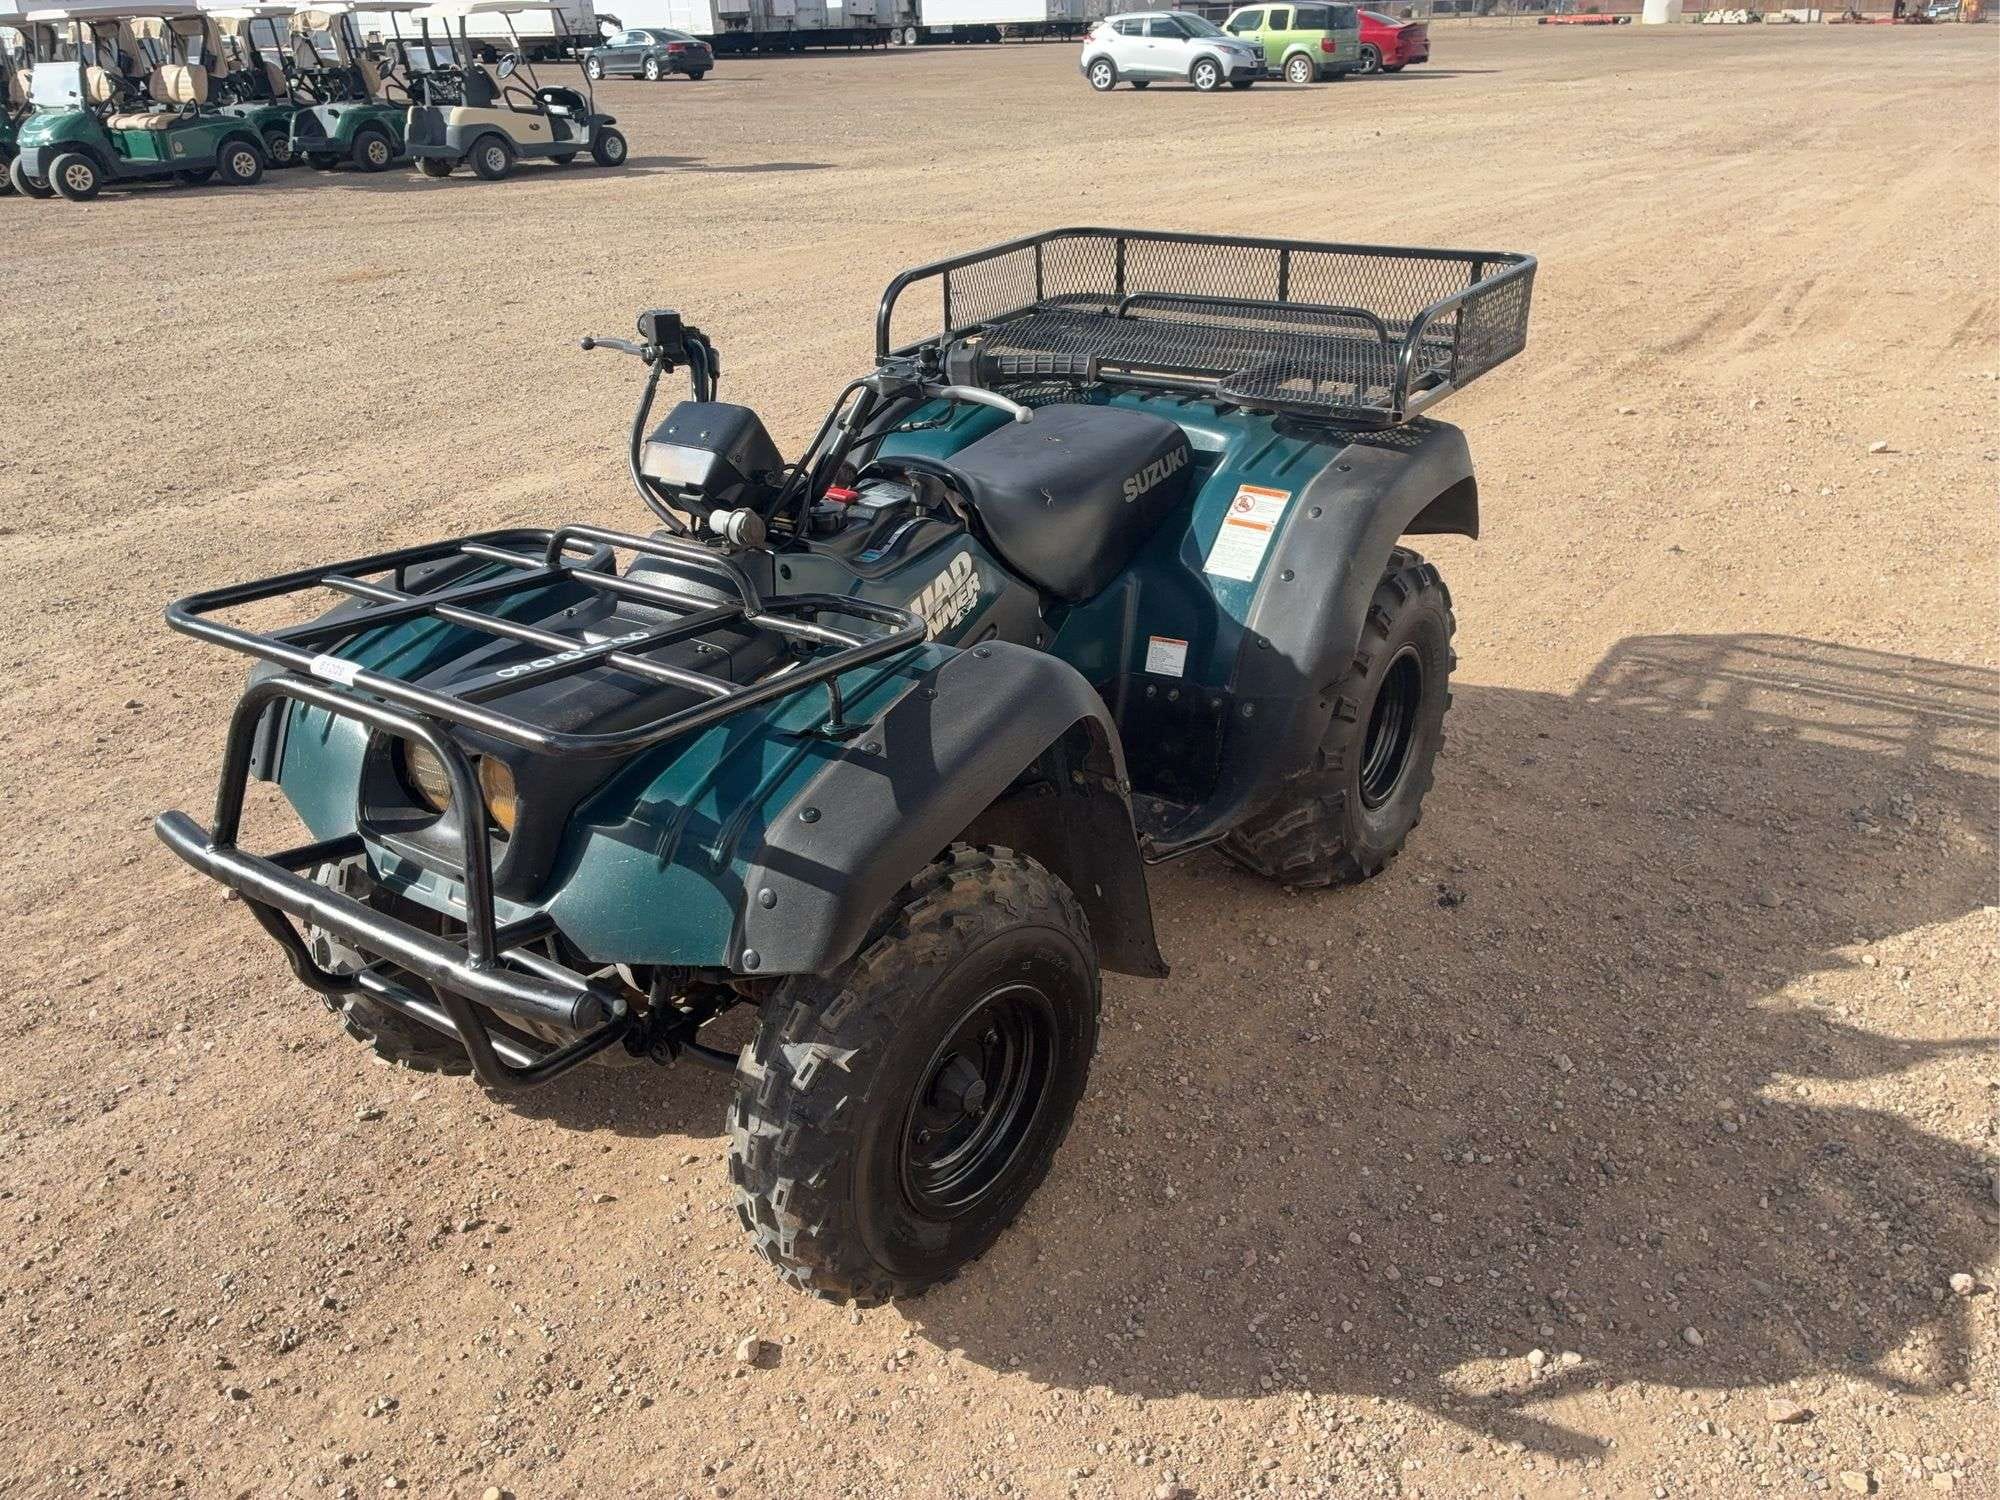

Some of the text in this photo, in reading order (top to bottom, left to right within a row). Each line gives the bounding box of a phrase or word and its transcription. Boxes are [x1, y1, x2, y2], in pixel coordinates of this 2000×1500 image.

[1123, 445, 1188, 503] SUZUKI
[910, 551, 972, 622] UAD
[925, 572, 981, 641] NNER
